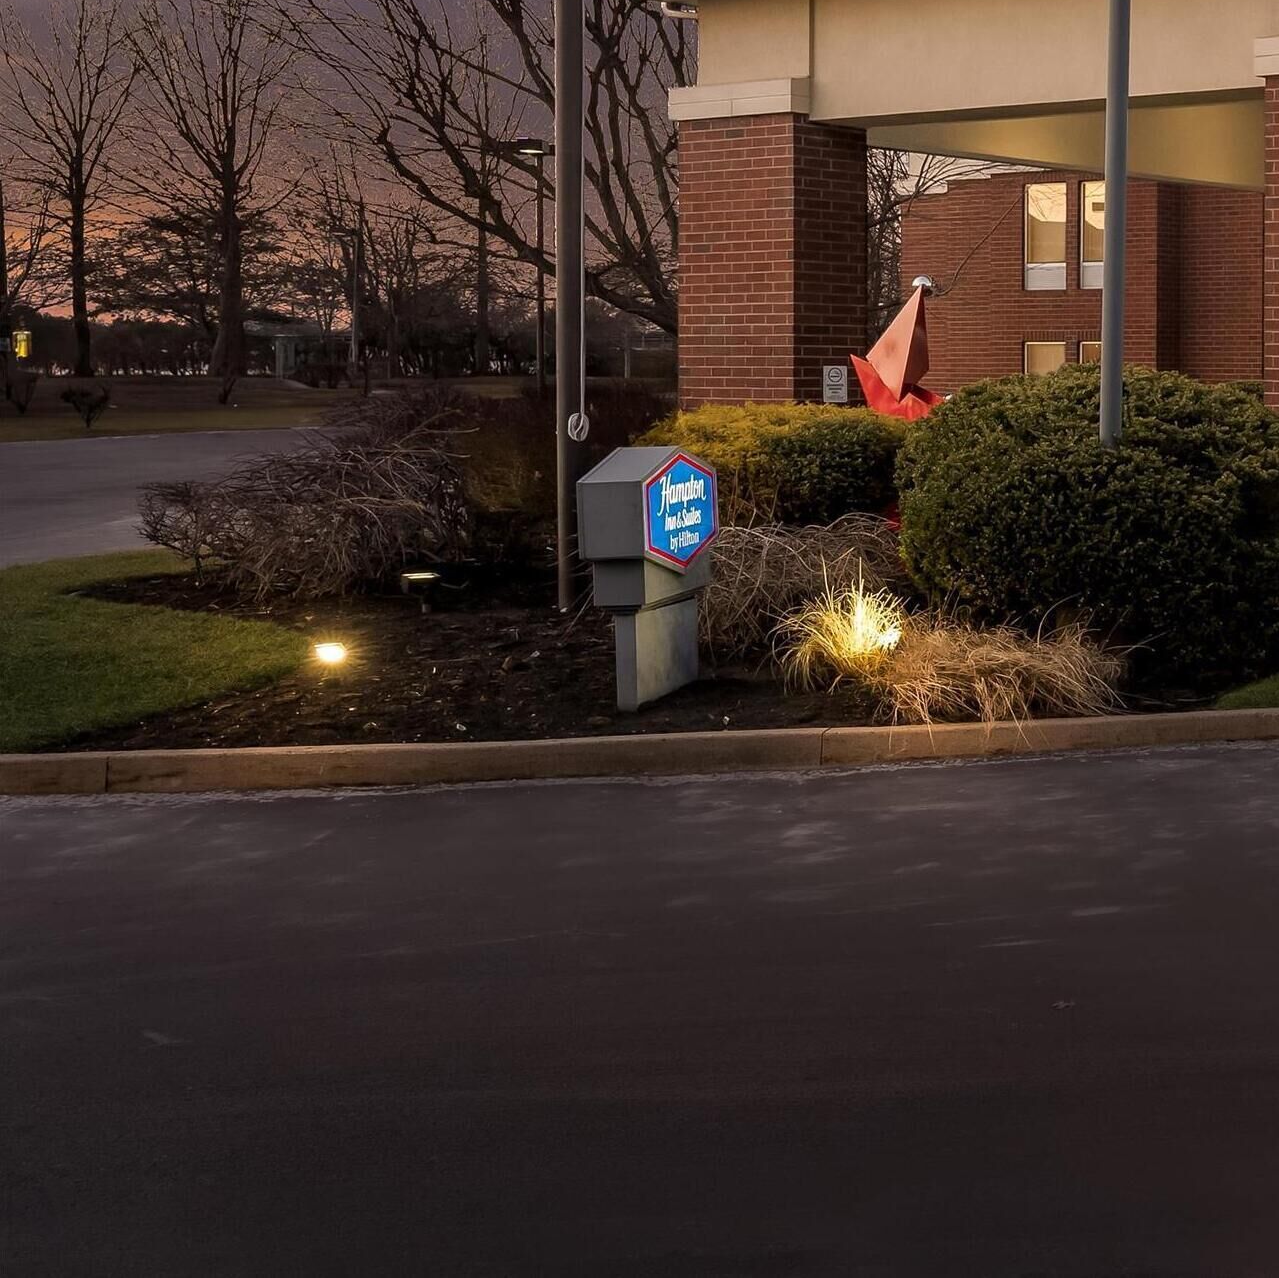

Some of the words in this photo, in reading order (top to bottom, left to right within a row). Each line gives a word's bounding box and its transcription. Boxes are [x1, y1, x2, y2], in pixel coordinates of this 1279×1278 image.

[657, 473, 707, 517] Hampton
[664, 512, 676, 532] Inn
[676, 511, 683, 529] &
[682, 506, 702, 527] Suites
[670, 534, 679, 554] by
[678, 530, 700, 548] Hilton
